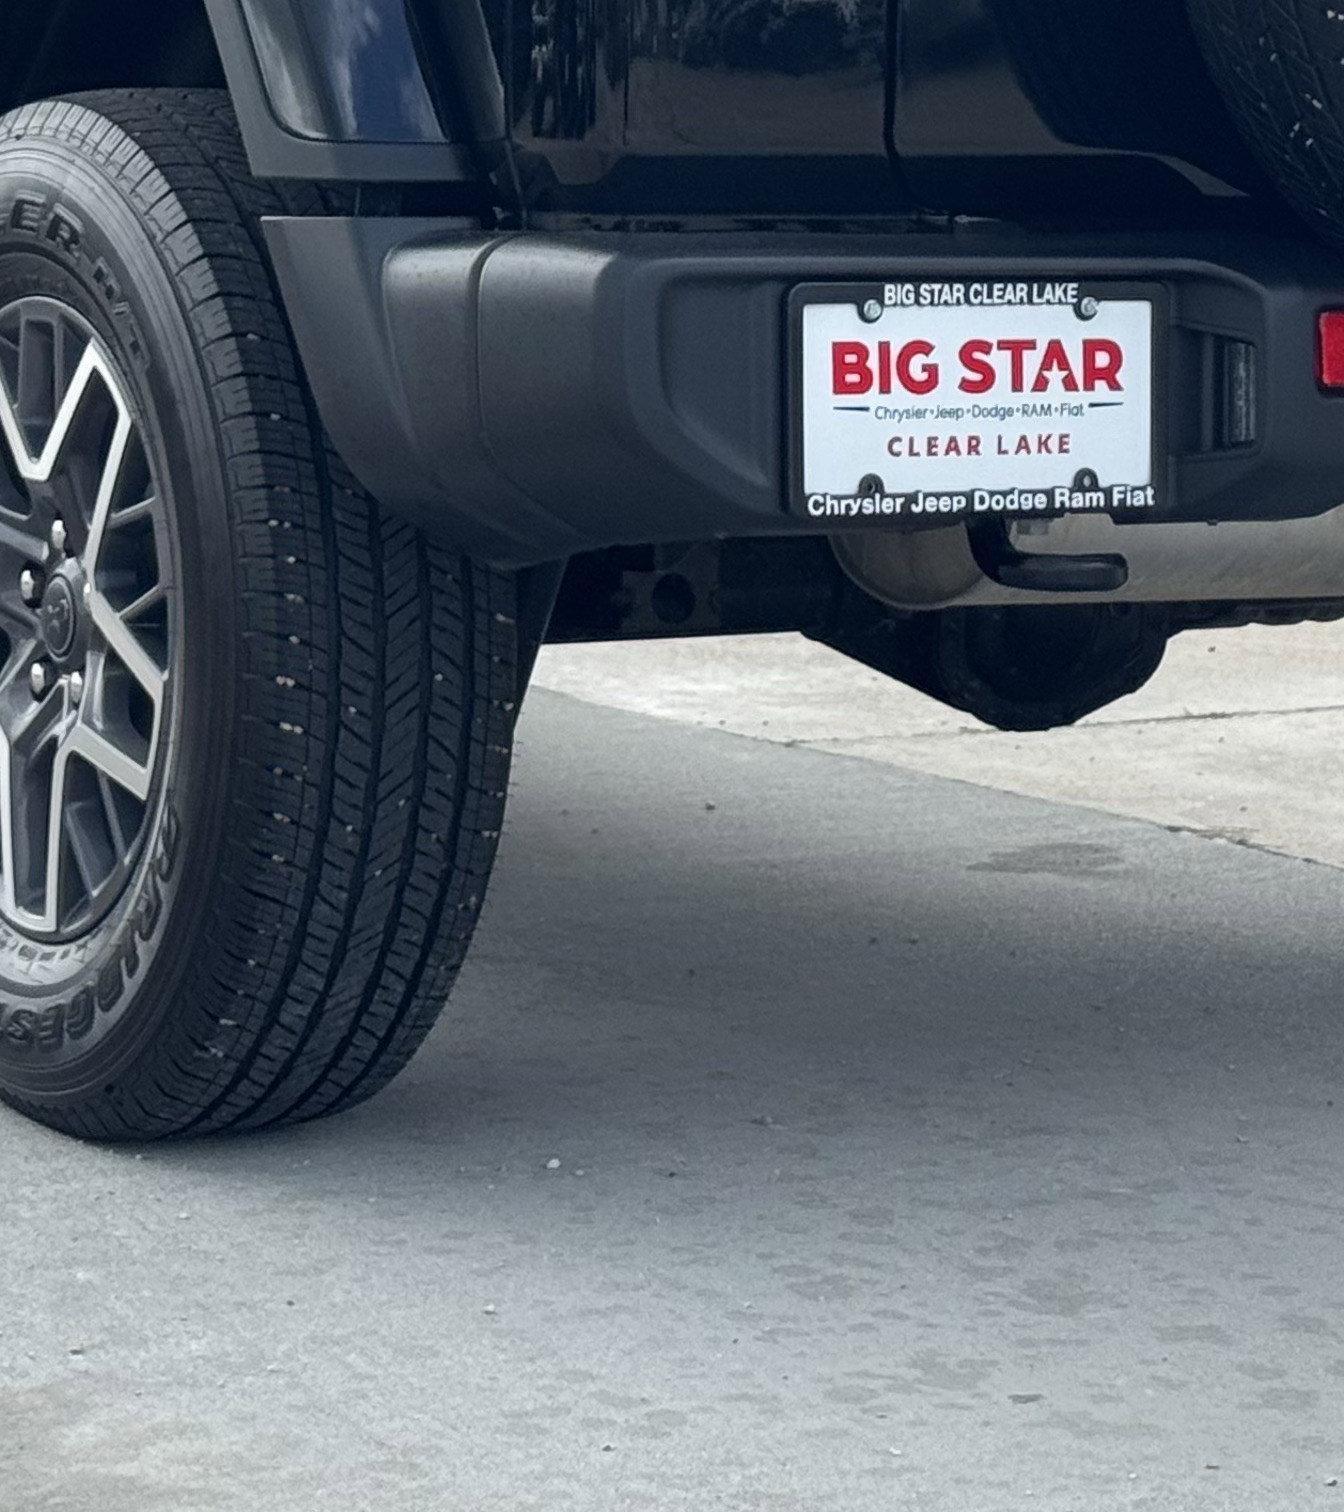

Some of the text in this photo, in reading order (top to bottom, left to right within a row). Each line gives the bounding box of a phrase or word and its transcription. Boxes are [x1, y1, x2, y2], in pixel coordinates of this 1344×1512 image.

[883, 282, 1079, 306] BIG STAR CLEAR LAKE
[831, 338, 1124, 395] BIG STAR
[874, 403, 1085, 423] Chrysler Jeep Dodge RAM Fiat
[887, 433, 1071, 458] CLEAR LAKE
[807, 486, 1155, 517] Chrysler Jeep Dodge Ram Fiat
